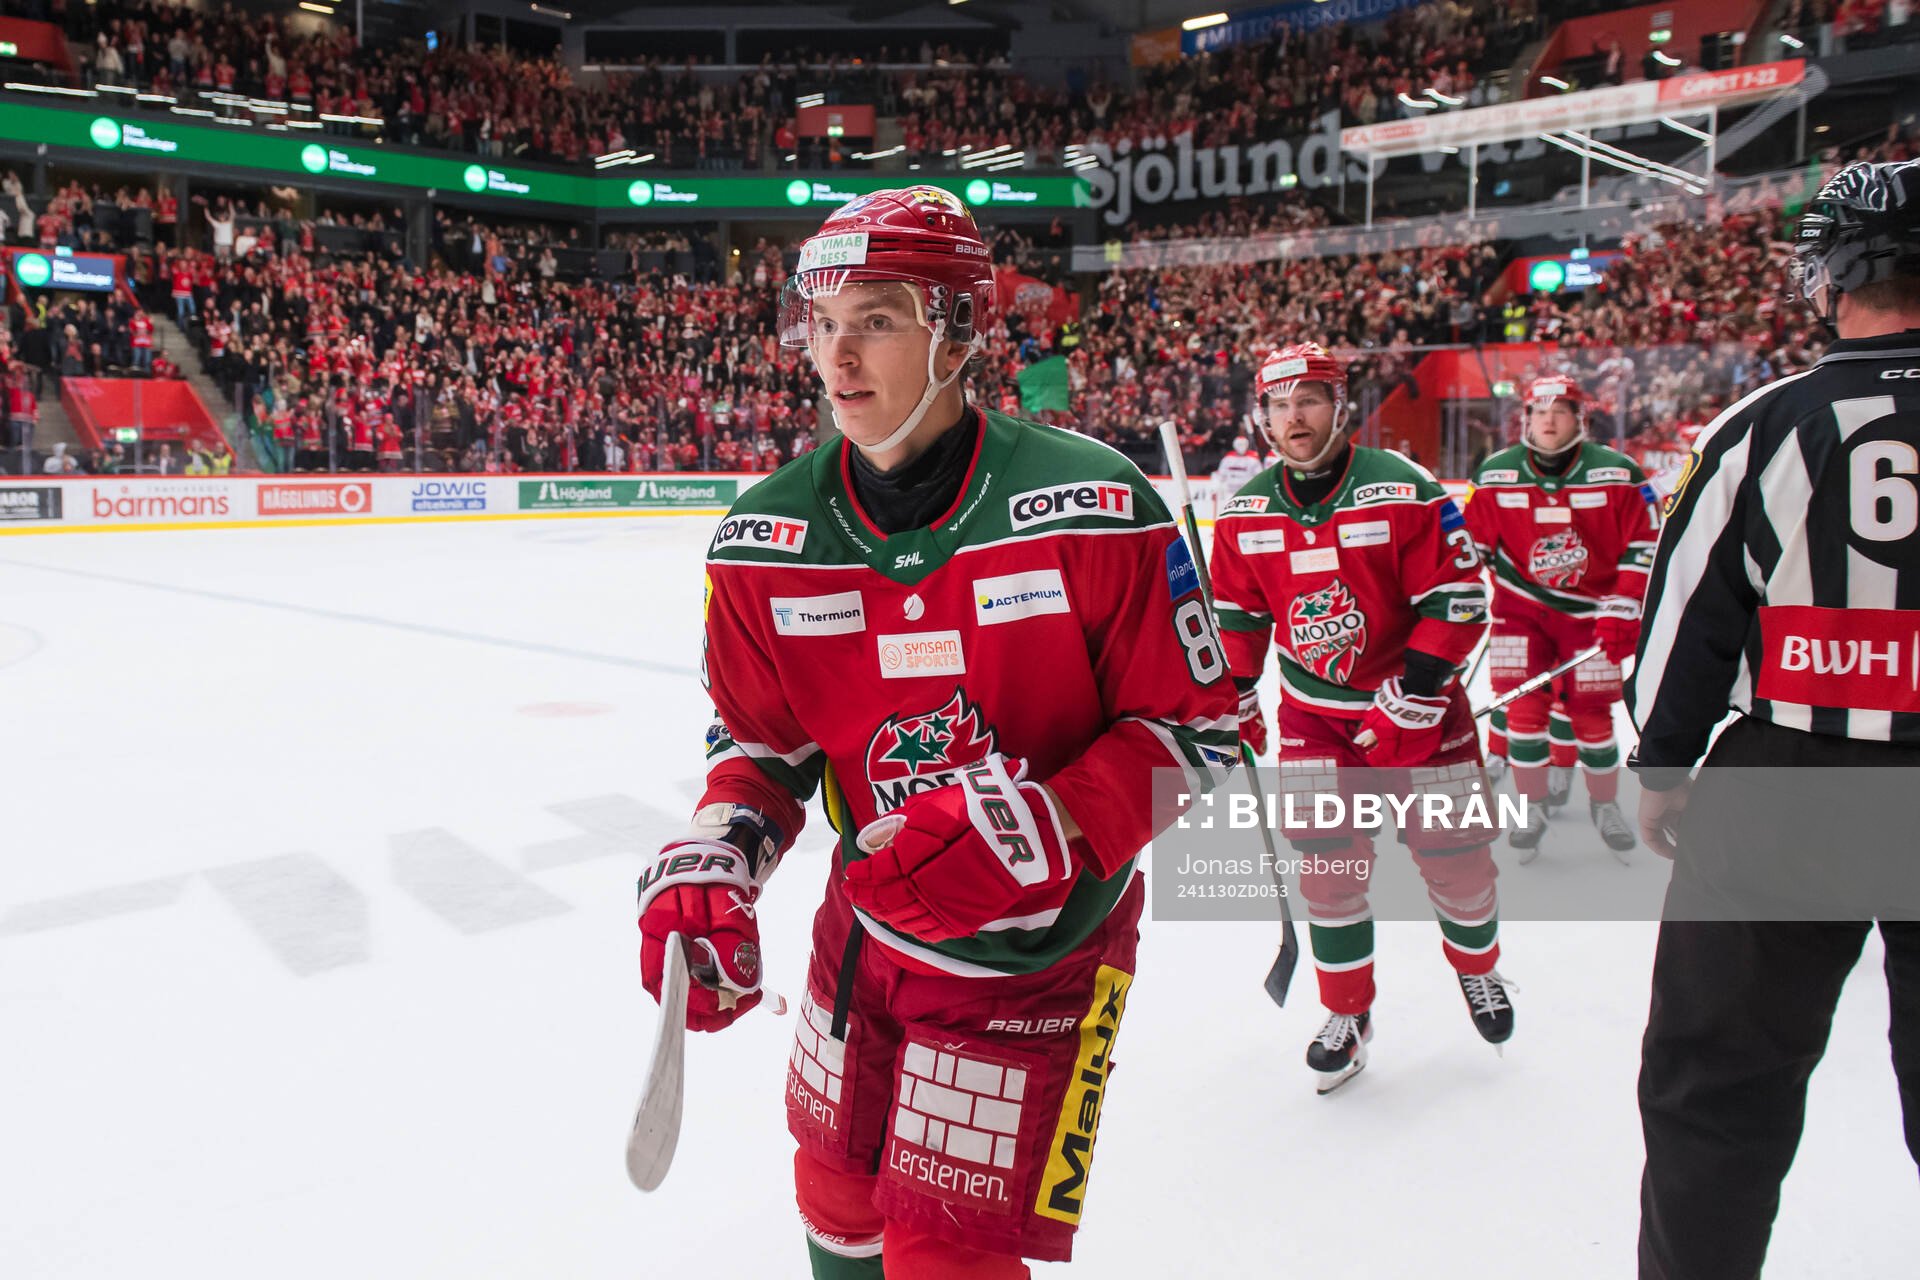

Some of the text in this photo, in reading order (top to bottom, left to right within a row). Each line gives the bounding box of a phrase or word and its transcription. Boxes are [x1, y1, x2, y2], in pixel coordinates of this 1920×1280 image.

[821, 235, 863, 250] VIMAB
[955, 244, 990, 257] BAUER
[820, 252, 848, 265] BESS
[412, 482, 487, 497] JOWIC
[560, 486, 612, 501] Högland
[659, 485, 716, 501] Högland
[1356, 485, 1414, 501] coreIT
[1849, 440, 1919, 541] 6
[1012, 485, 1131, 522] coreIT
[717, 519, 805, 546] coreIT
[894, 551, 925, 569] SHL
[1534, 548, 1586, 568] MODO
[995, 589, 1063, 607] ACTEMIUM
[798, 607, 861, 623] Thermion
[1293, 612, 1363, 645] MODO
[904, 639, 957, 655] SYNSAM
[1175, 599, 1227, 685] 8
[1302, 631, 1360, 665] HOCKEY
[906, 653, 960, 668] SPORTS
[1781, 634, 1899, 676] BWH
[986, 1016, 1077, 1035] BAUER
[1049, 981, 1124, 1215] Malux
[889, 1141, 1009, 1202] Lerstenen.
